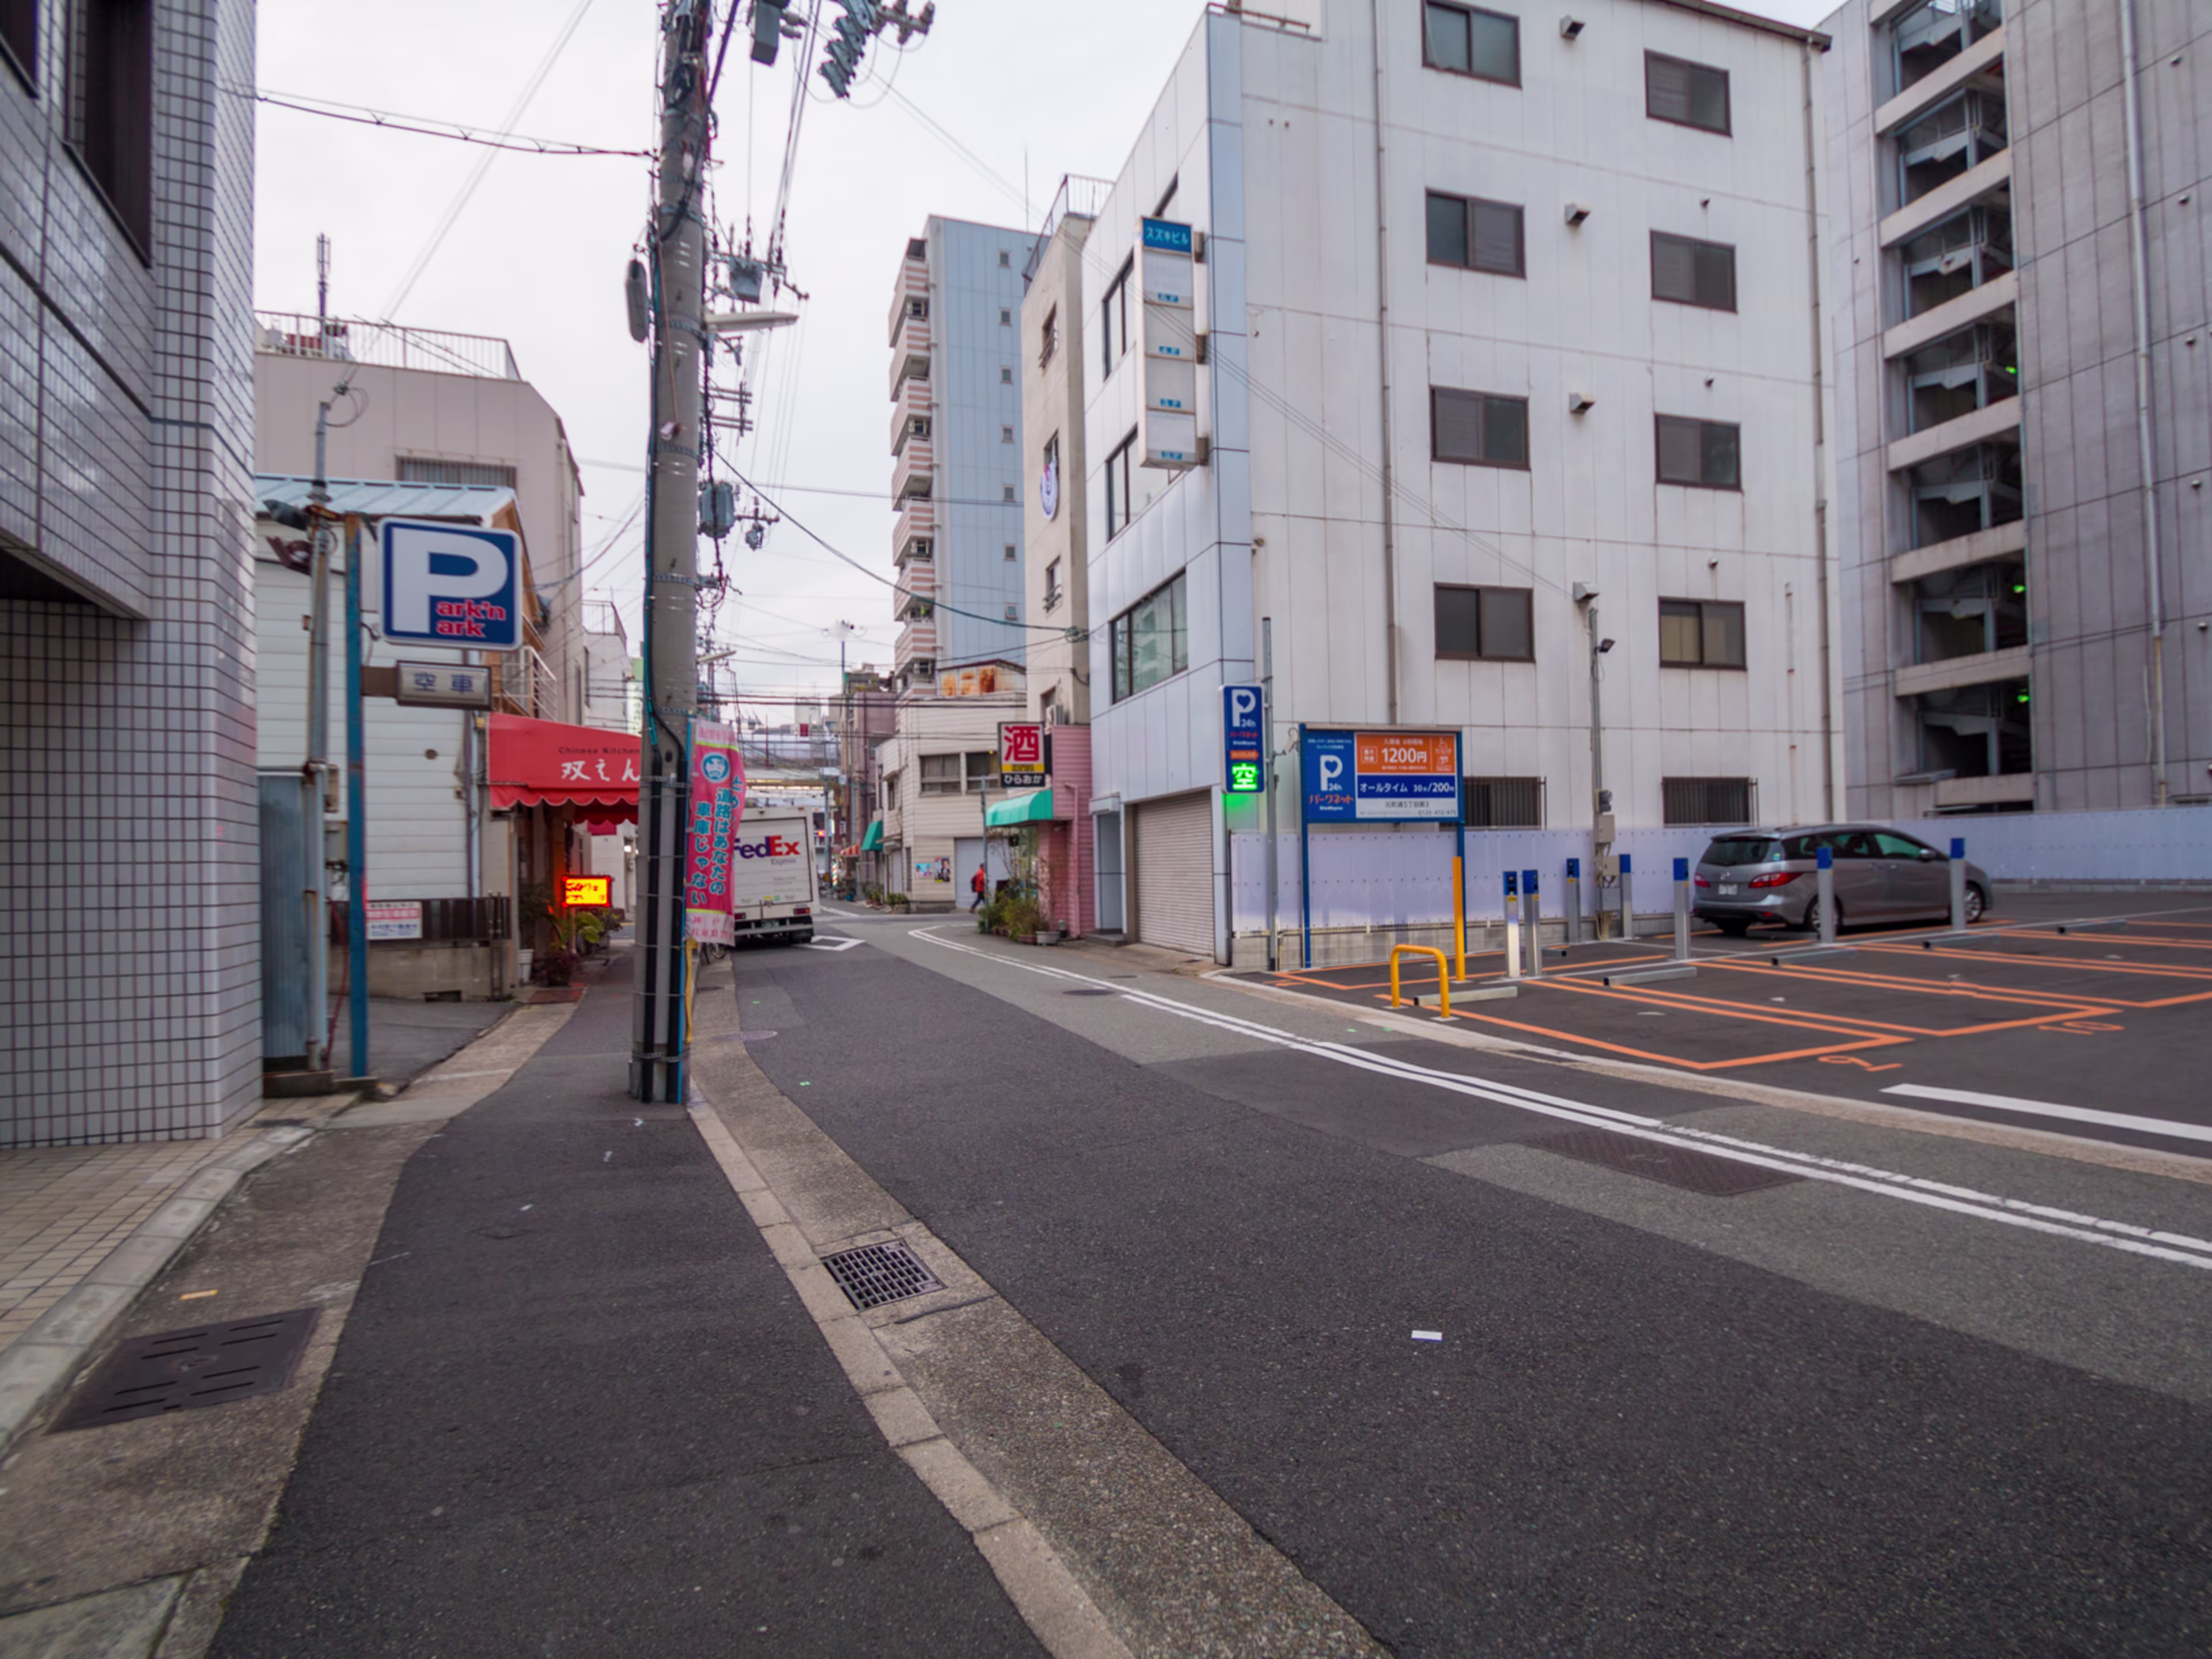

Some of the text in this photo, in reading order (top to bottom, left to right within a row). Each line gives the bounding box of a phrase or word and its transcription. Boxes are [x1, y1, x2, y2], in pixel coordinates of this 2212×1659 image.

[392, 528, 507, 634] P
[414, 673, 474, 692] 空車
[1232, 689, 1256, 727] P
[558, 747, 599, 755] Chinese
[1005, 726, 1039, 761] 酒
[1381, 748, 1427, 763] 1200円
[1004, 775, 1043, 784] ひらおか
[1233, 763, 1256, 789] 空
[1320, 755, 1343, 791] P
[1309, 794, 1354, 805] パークネット
[1360, 783, 1408, 793] オールタイム
[692, 801, 712, 905] 車庫じゃない
[710, 788, 732, 896] 道路はあなたの
